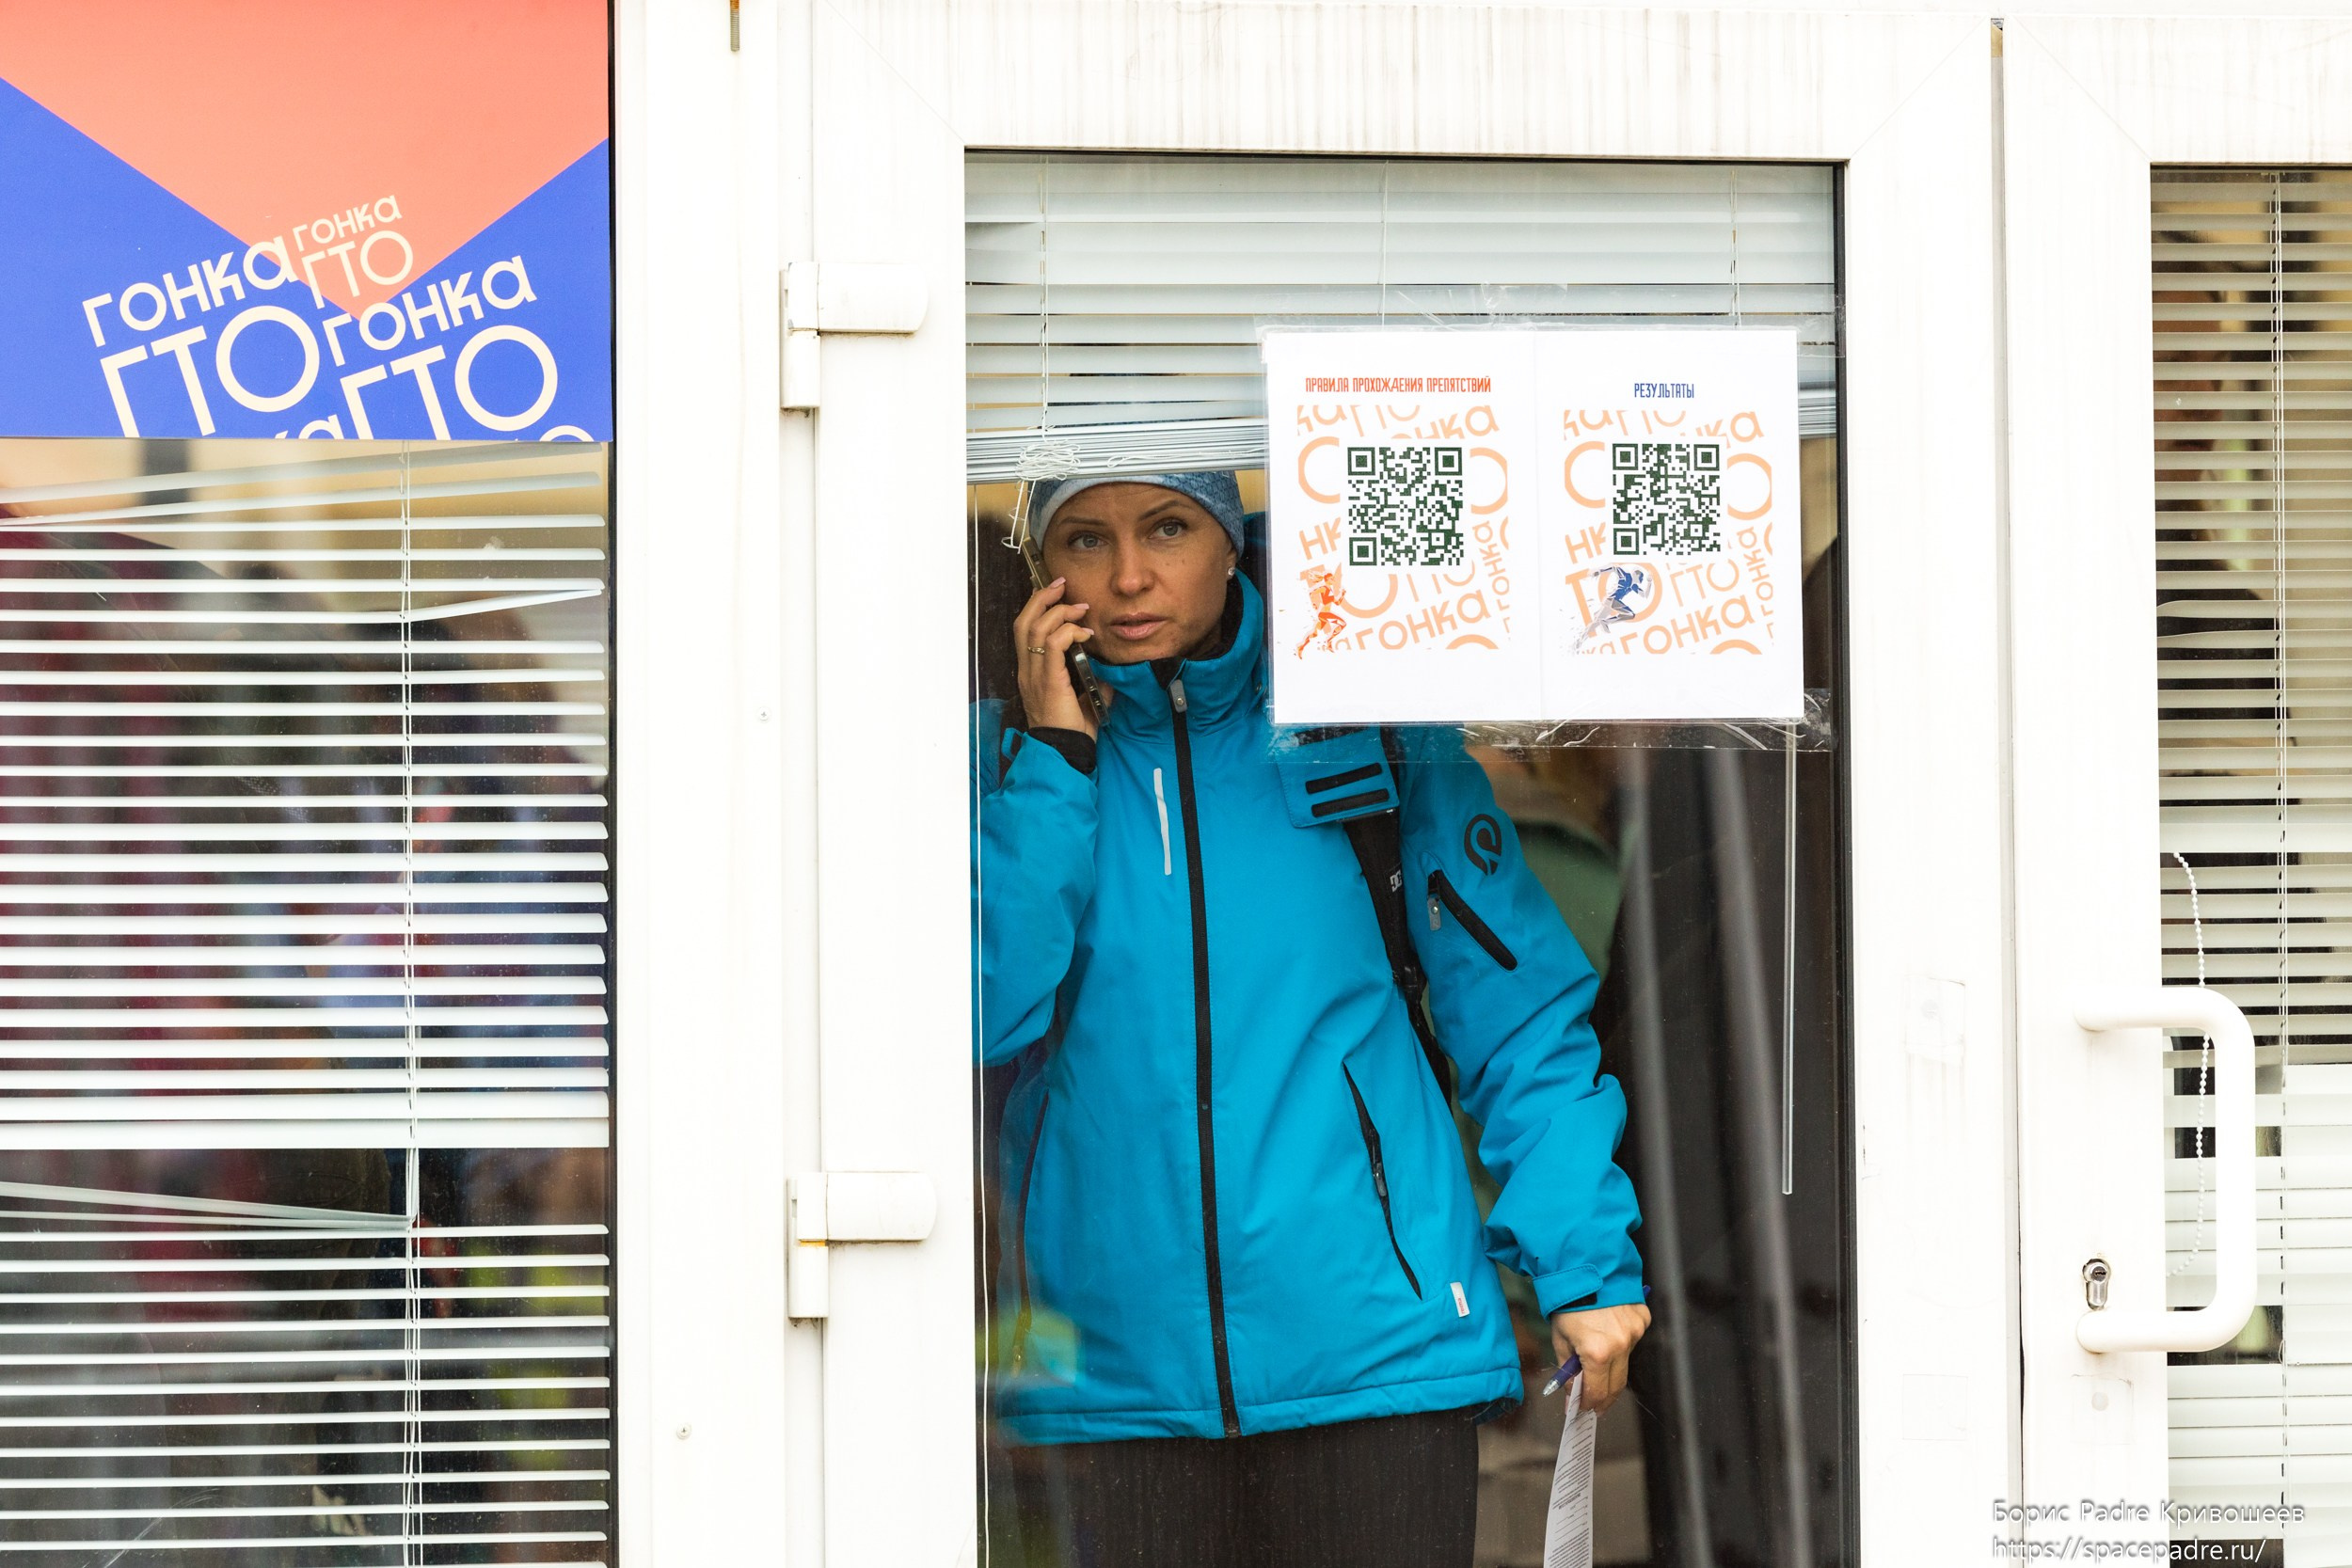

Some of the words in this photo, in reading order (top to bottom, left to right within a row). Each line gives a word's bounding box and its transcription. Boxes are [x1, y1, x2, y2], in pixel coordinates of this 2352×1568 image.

[1305, 376, 1349, 393] ПРАВИЛА
[1353, 376, 1423, 393] ПРОХОЖДЕНИЯ
[1426, 375, 1492, 393] ПРЕПЯТСТВИЙ
[1633, 383, 1695, 399] РЕЗУЛЬТАТЫ
